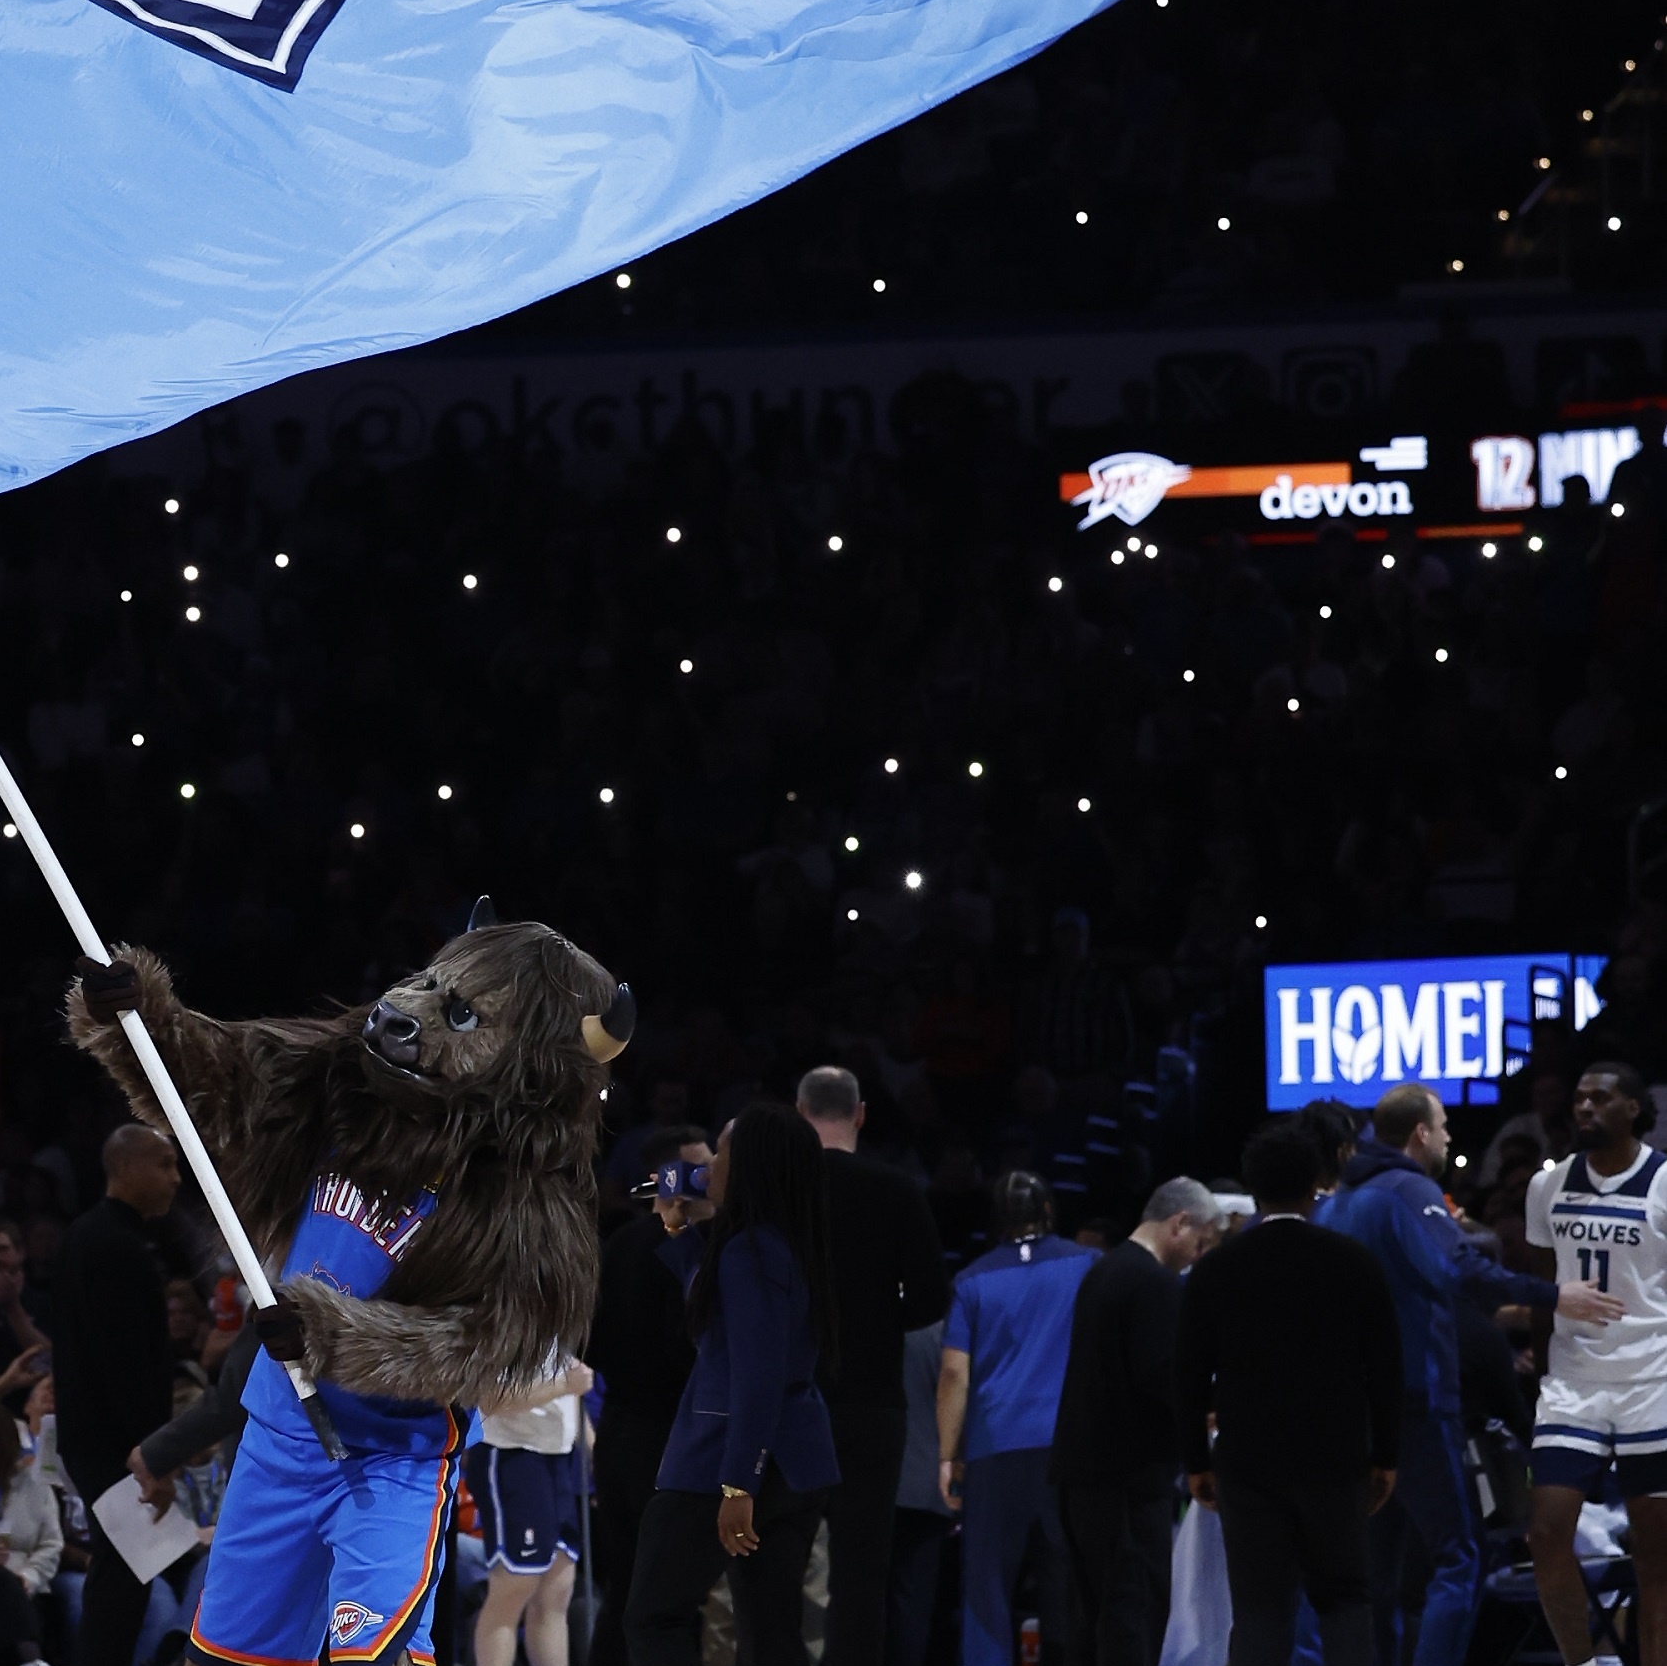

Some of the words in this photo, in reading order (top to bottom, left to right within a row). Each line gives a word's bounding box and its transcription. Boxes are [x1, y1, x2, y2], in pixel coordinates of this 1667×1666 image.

[1260, 475, 1413, 520] devon
[1553, 1221, 1641, 1246] WOLVES
[1576, 1248, 1609, 1293] 11
